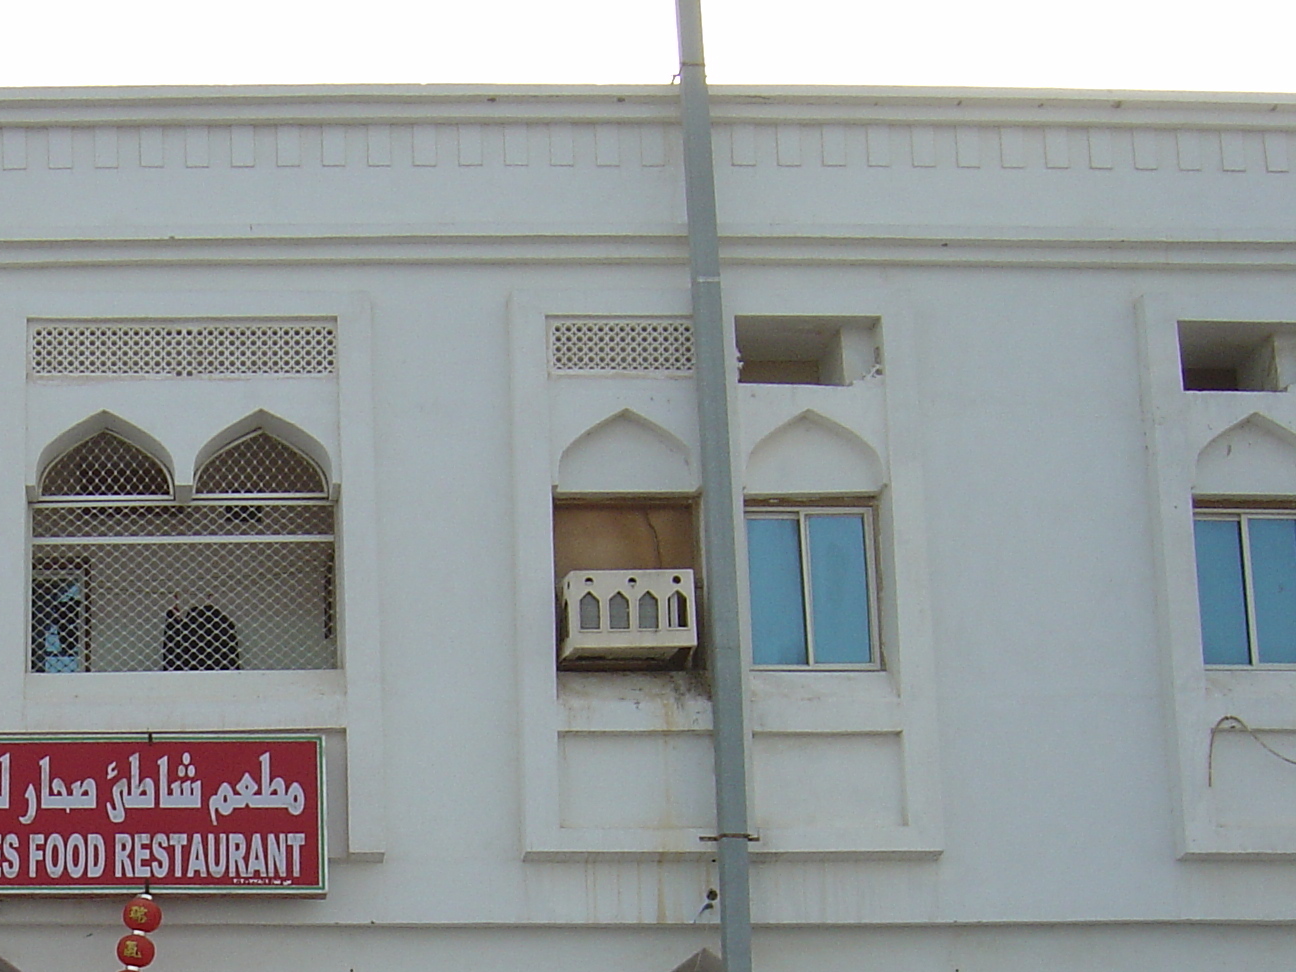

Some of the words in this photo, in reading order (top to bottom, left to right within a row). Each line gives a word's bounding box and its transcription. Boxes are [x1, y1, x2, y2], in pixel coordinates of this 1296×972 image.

[18, 755, 97, 824] صحار
[208, 751, 305, 826] مطعم
[28, 833, 106, 879] FOOD
[114, 833, 306, 879] RESTAURANT
